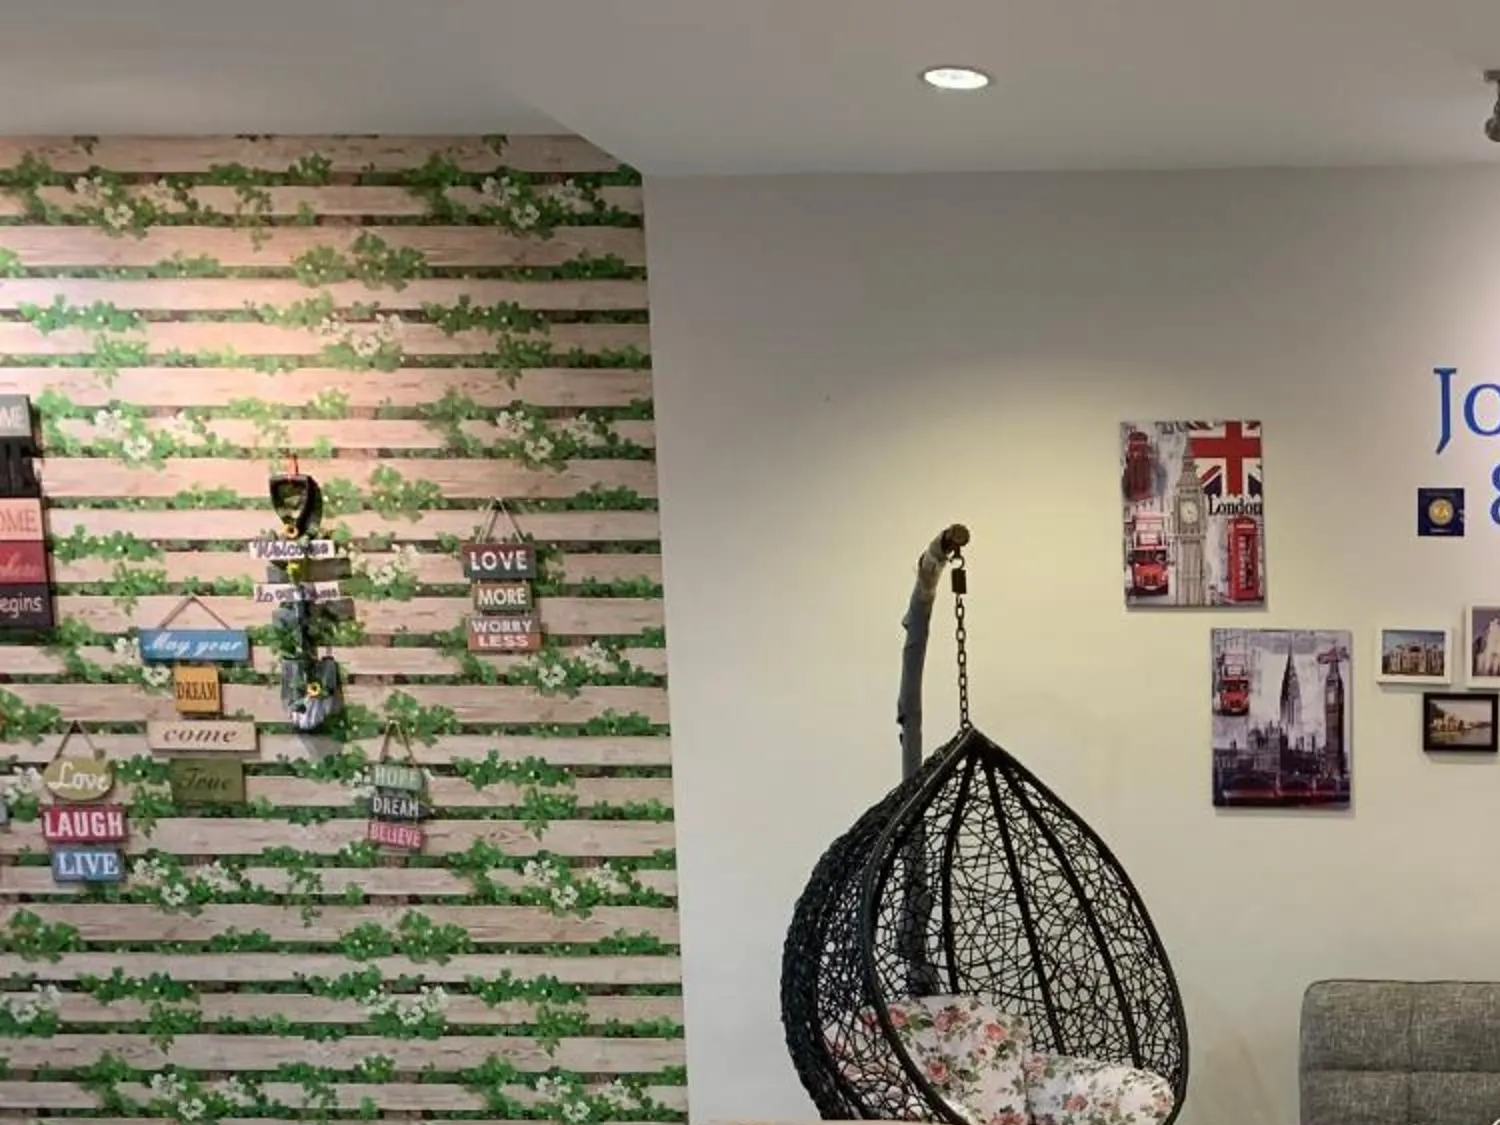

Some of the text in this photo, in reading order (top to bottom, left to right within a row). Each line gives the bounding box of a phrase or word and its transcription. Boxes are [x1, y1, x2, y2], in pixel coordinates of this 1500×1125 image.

[1208, 495, 1263, 516] London
[469, 550, 529, 572] LOVE
[477, 587, 527, 605] MORE
[471, 619, 533, 633] WORRY
[144, 632, 243, 657] May your
[478, 634, 529, 648] LESS
[176, 681, 217, 701] DREAM
[163, 728, 239, 744] come
[47, 761, 110, 792] Love
[181, 767, 231, 792] True
[374, 766, 418, 789] HOPE
[372, 797, 420, 817] DREAM
[44, 811, 124, 838] LAUGH
[370, 822, 422, 847] BELIEVE
[56, 852, 120, 876] LIVE
